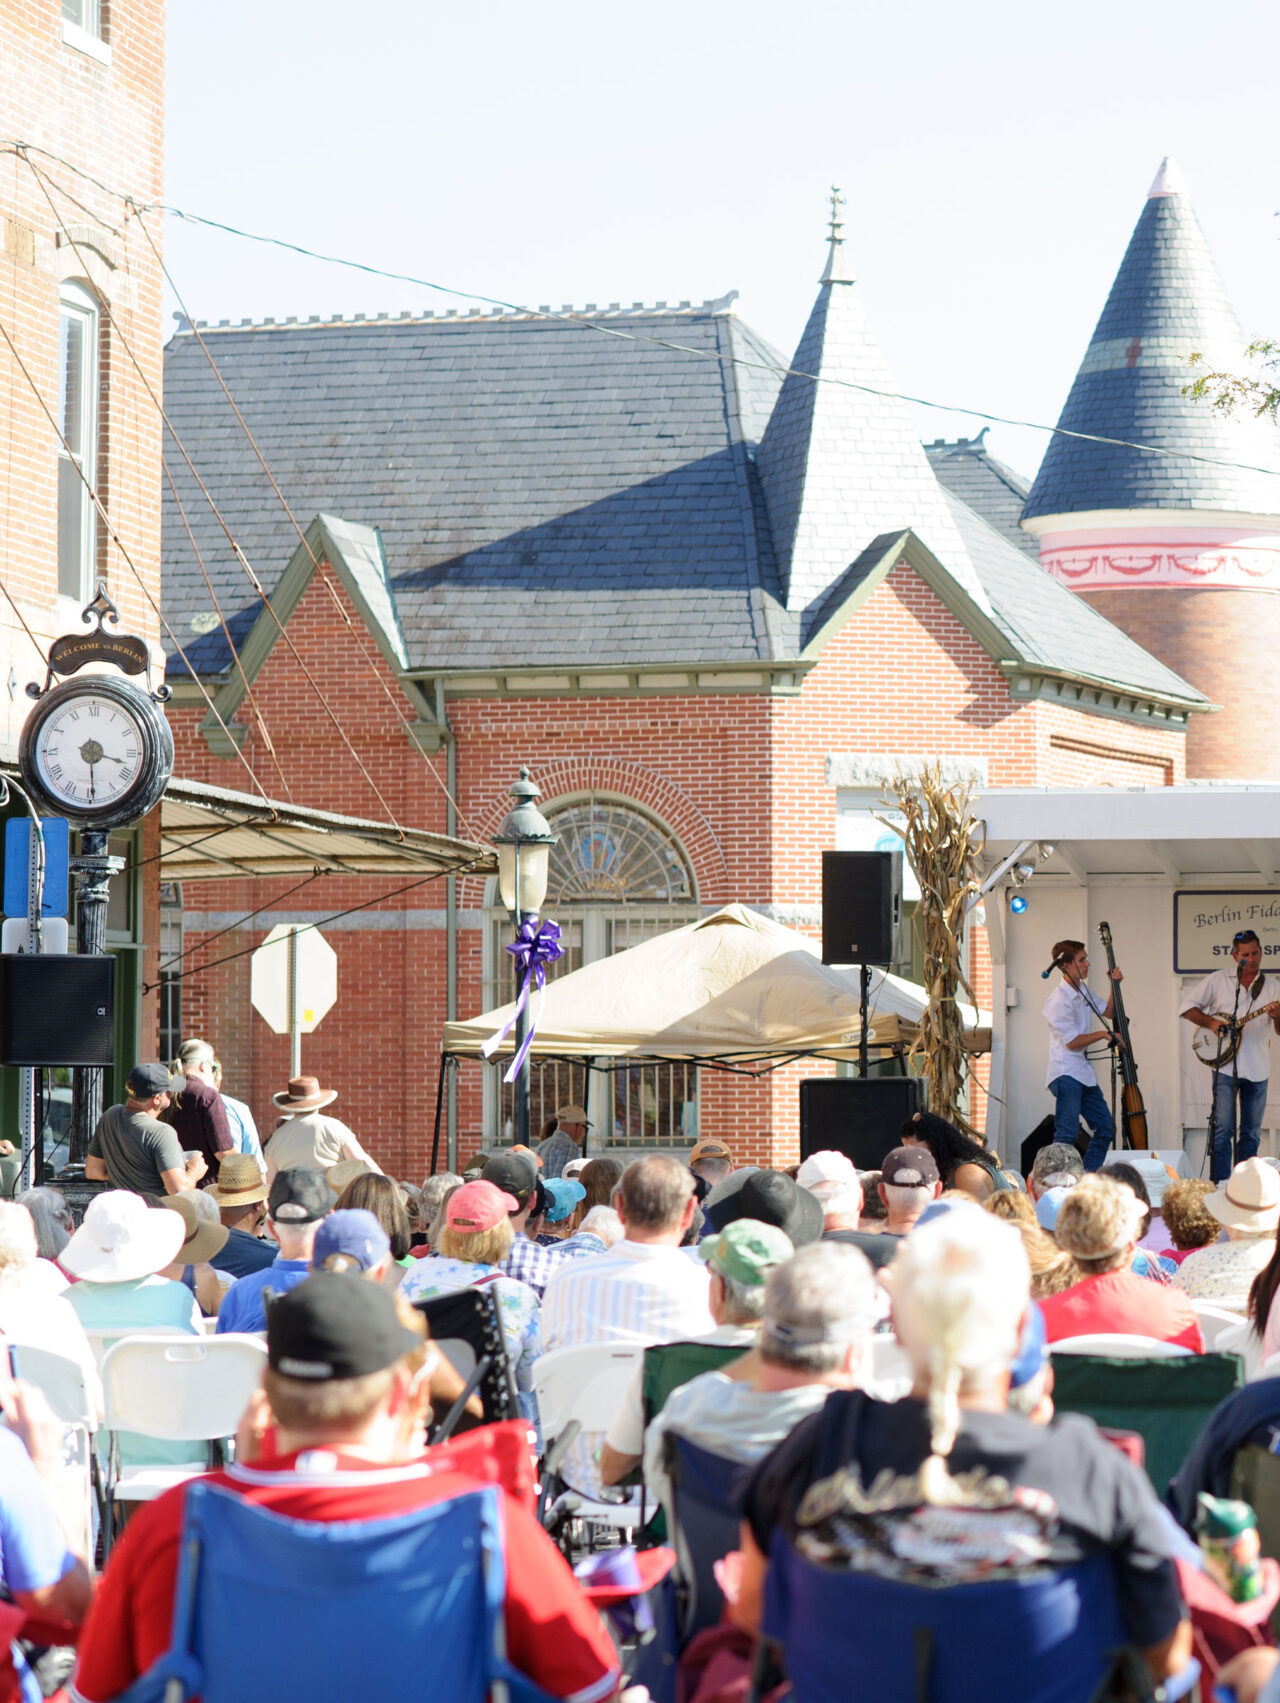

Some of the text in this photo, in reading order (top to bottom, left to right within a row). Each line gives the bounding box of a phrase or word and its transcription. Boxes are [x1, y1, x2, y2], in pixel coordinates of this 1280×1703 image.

[54, 642, 100, 661] WELCOME
[112, 644, 142, 663] BERLIN
[88, 706, 100, 717] XII
[126, 749, 137, 758] III
[1193, 905, 1242, 928] Berlin
